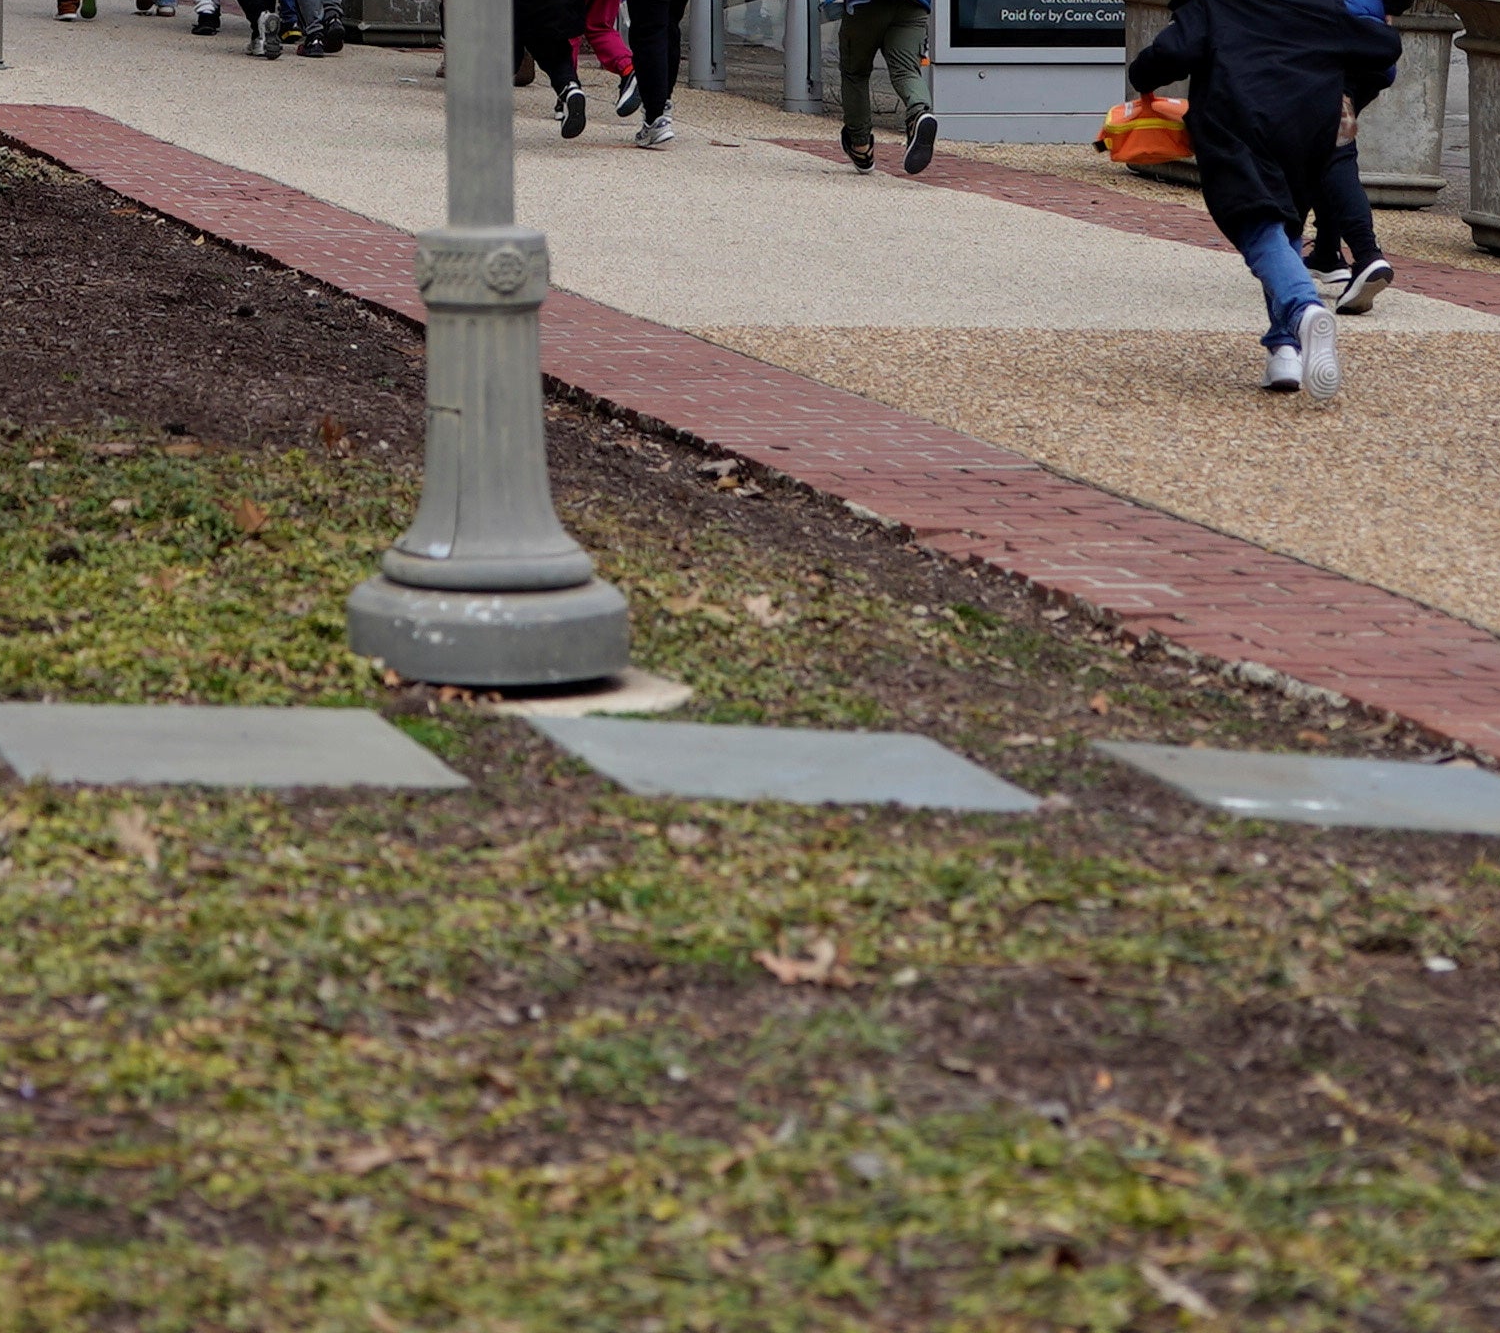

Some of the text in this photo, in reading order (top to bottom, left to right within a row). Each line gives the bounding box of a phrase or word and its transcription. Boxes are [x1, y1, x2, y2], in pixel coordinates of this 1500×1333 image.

[1001, 9, 1027, 21] Paid
[1029, 9, 1048, 21] for
[1049, 10, 1063, 23] by
[1064, 10, 1094, 21] Care
